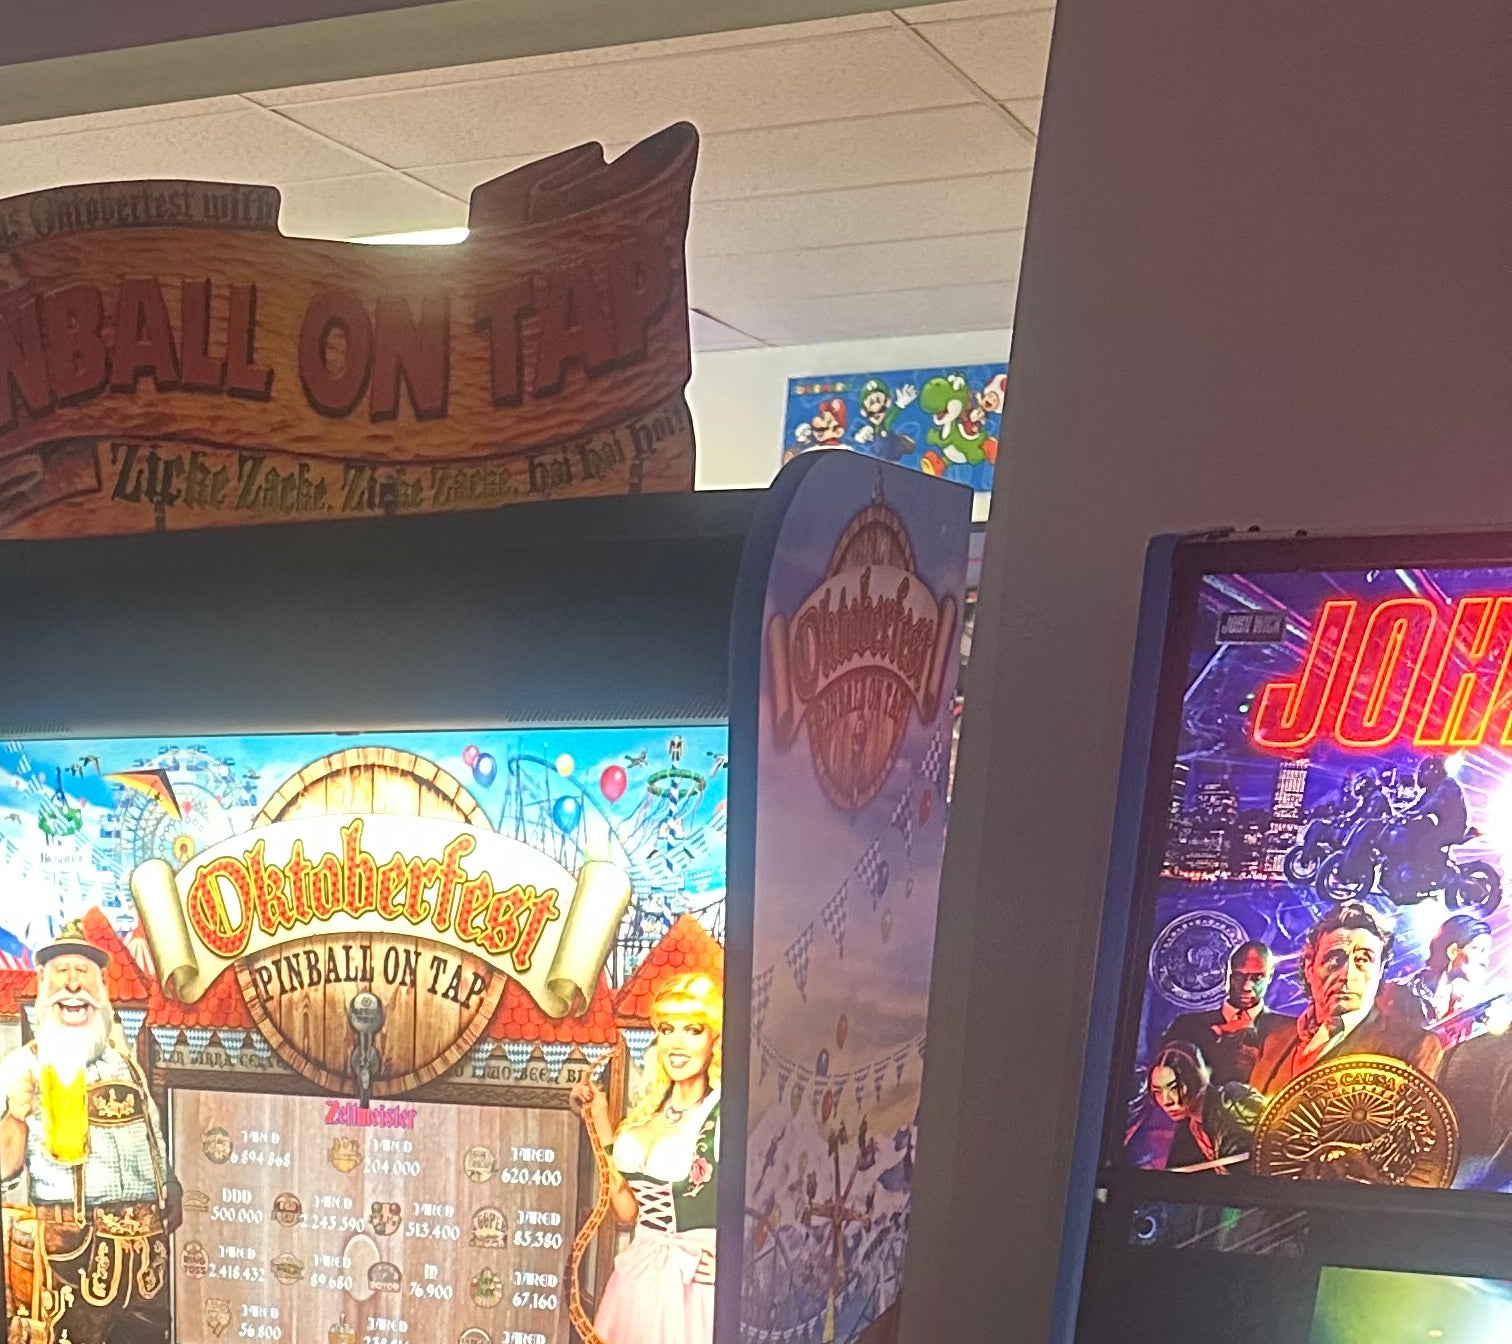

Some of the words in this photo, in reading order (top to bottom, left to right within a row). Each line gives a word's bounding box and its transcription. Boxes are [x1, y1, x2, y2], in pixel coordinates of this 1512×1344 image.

[299, 286, 451, 423] ON
[474, 244, 678, 410] TAP
[187, 818, 560, 972] Oktoberfest
[256, 944, 376, 1001] PINBALL
[383, 946, 421, 987] ON
[430, 959, 486, 1009] TAP
